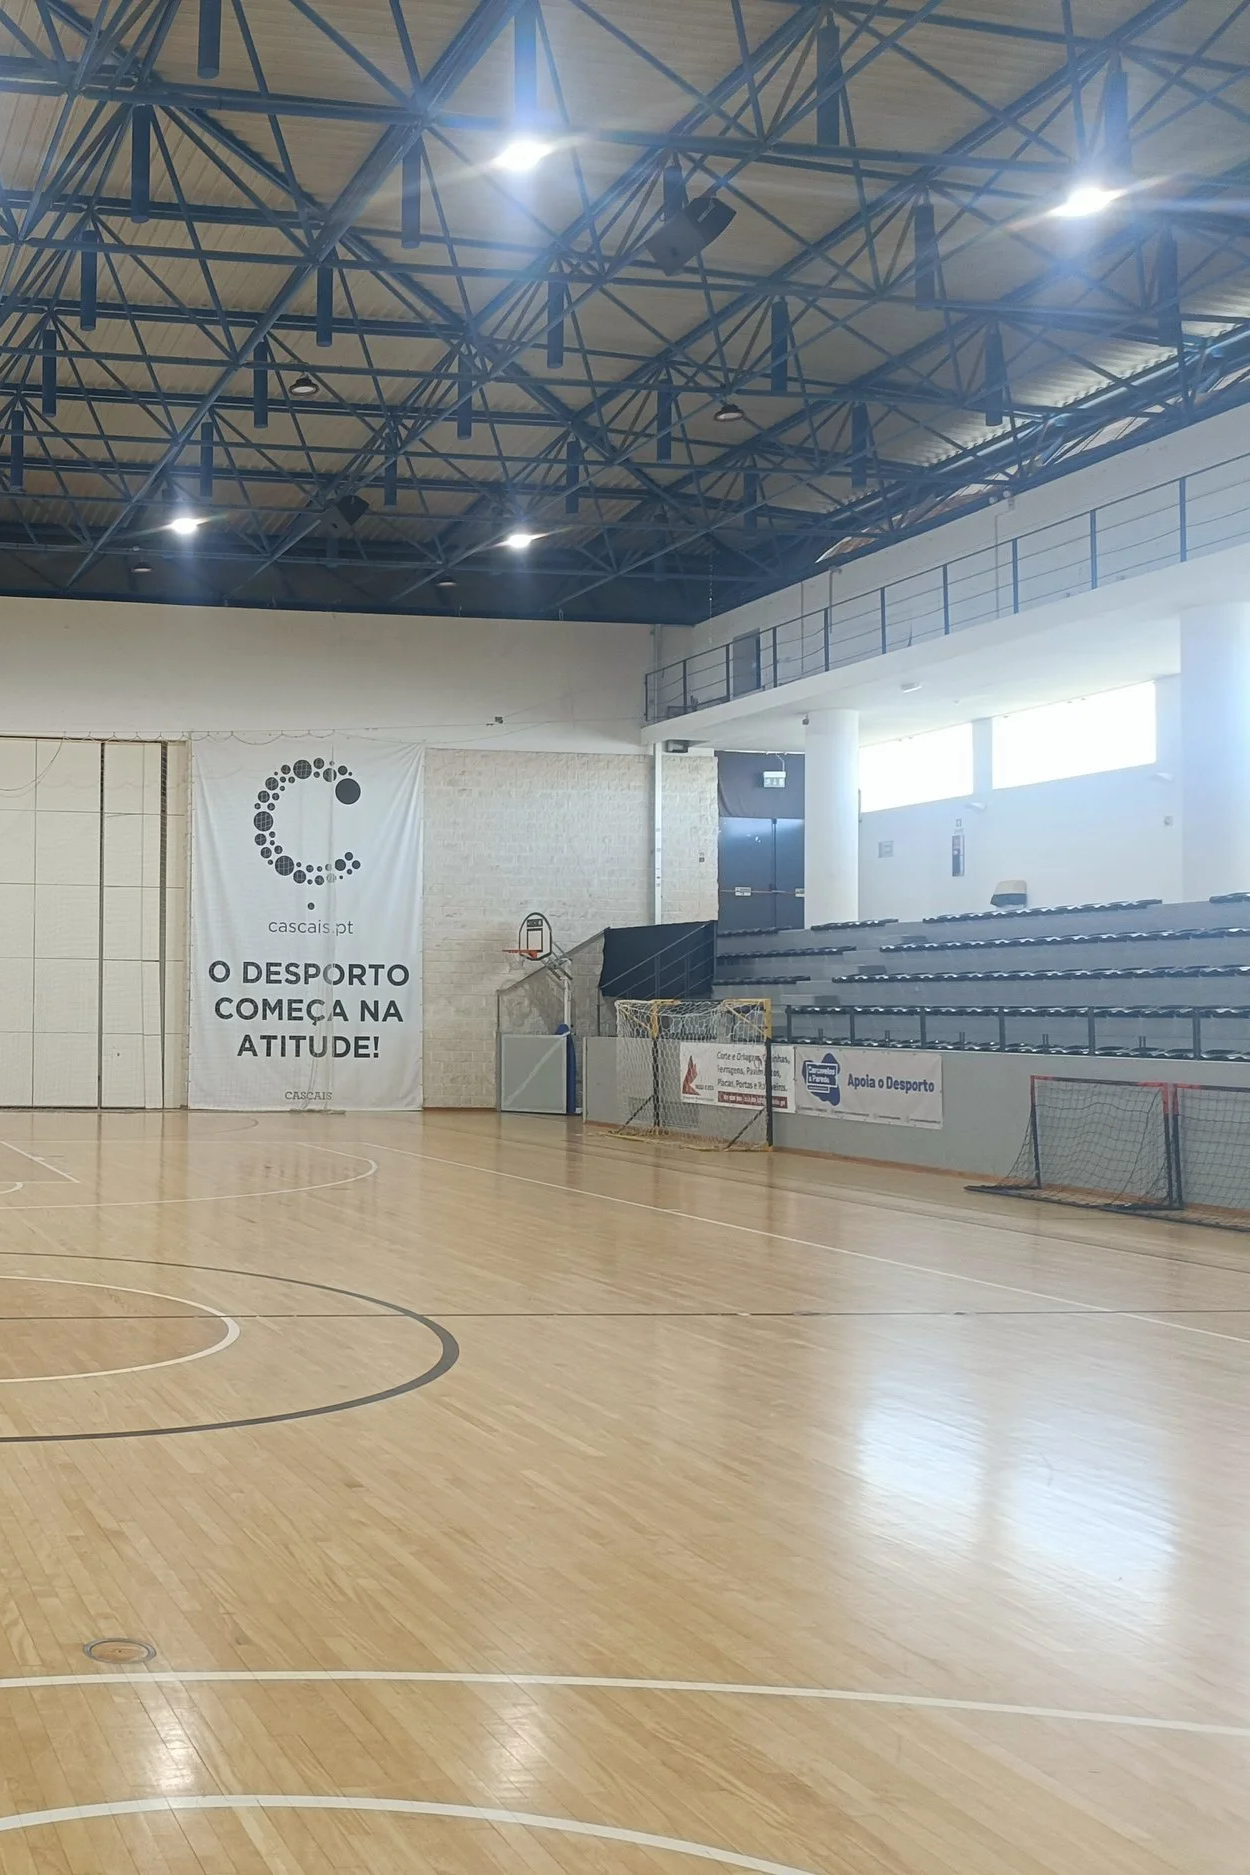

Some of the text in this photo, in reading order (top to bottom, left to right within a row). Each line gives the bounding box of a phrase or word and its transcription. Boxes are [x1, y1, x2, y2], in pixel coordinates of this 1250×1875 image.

[268, 919, 354, 937] cascais.pt
[208, 960, 410, 987] O DESPORTO
[214, 997, 404, 1026] COMEÇA NA
[237, 1034, 380, 1059] ATITUDE!
[847, 1073, 935, 1094] Apoia o Desporto
[284, 1091, 333, 1101] CASCAIS
